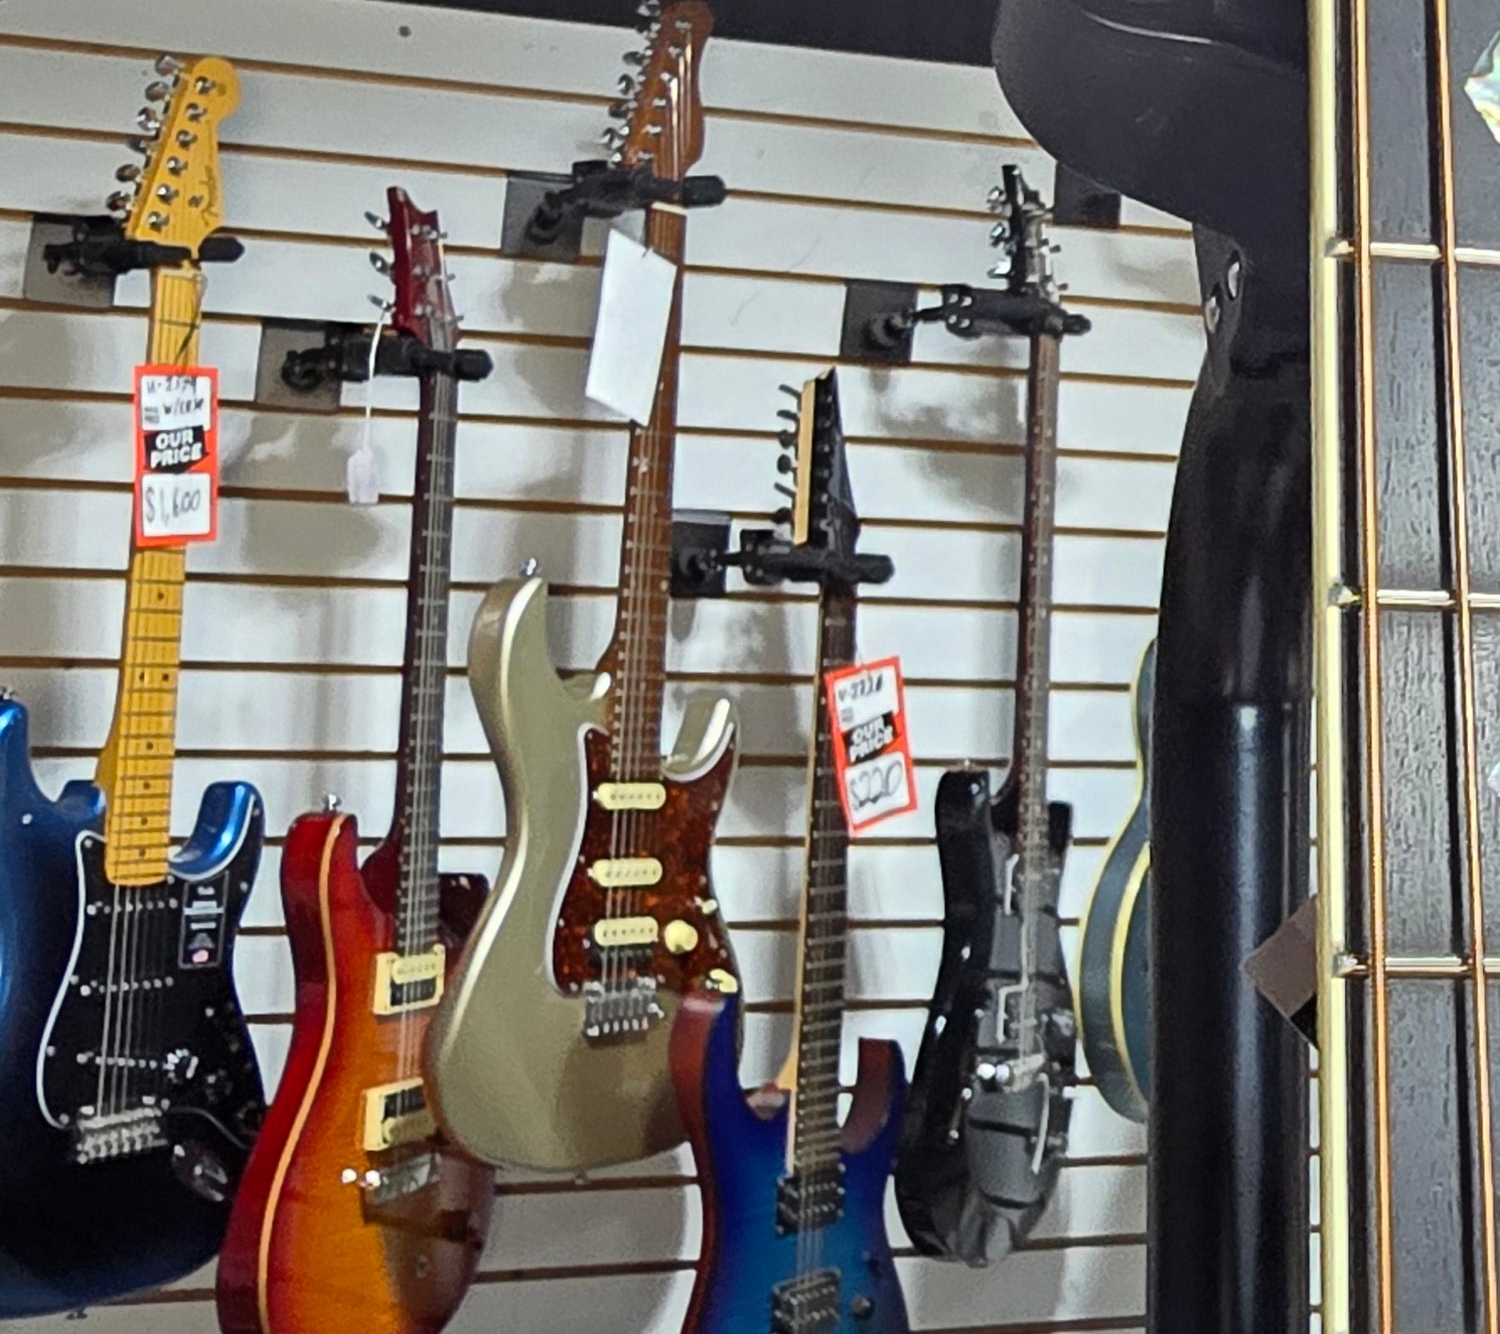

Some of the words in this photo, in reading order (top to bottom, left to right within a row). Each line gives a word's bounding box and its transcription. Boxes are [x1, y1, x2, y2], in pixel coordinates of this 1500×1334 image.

[155, 429, 194, 451] OUR
[150, 442, 202, 469] PRICE
[848, 726, 894, 764] PRICE
